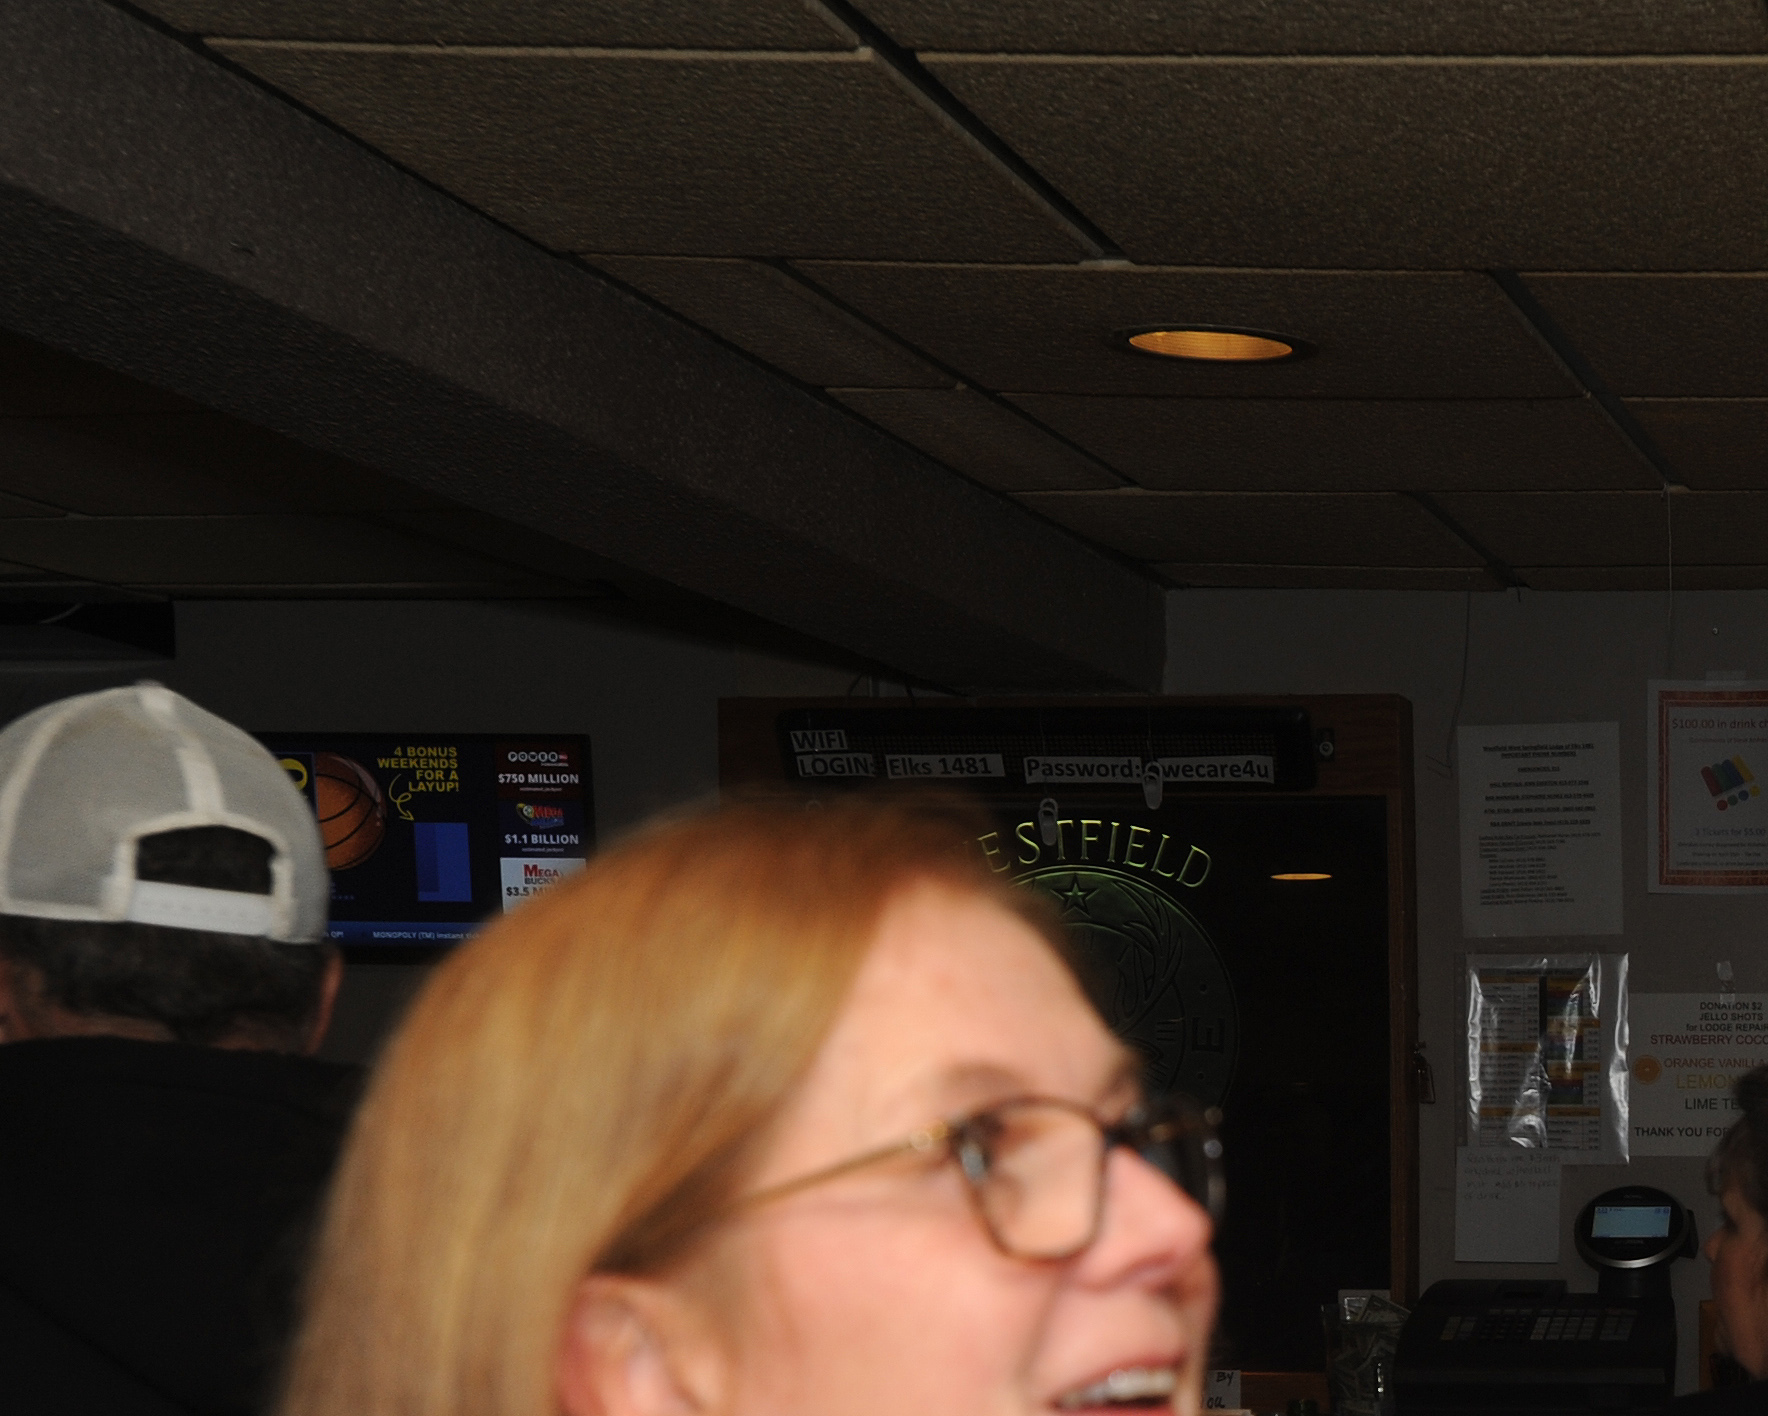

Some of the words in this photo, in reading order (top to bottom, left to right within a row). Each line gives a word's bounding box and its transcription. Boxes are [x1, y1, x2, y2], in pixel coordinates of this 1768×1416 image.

[1672, 719, 1715, 730] $100.00
[1717, 720, 1727, 729] in
[1730, 719, 1756, 730] drink
[793, 731, 844, 750] WIFI
[393, 746, 403, 757] 4
[406, 746, 458, 758] BONUS
[376, 758, 459, 769] WEEKENDS
[889, 758, 931, 776] Elks
[938, 757, 991, 775] 1481
[1027, 759, 1141, 778] Password:
[415, 770, 444, 781] FOR
[449, 770, 459, 780] A
[498, 773, 525, 784] $750
[528, 773, 579, 784] MILLION
[408, 782, 460, 793] LAYUP!
[504, 834, 528, 844] $1.1
[531, 834, 579, 845] BILLION
[964, 819, 1212, 888] ESTFIELD
[372, 931, 417, 939] MONOPOLY
[1700, 1001, 1749, 1011] DONATION
[1751, 1001, 1763, 1012] $2
[1700, 1012, 1728, 1022] JELLO
[1731, 1012, 1764, 1022] SHOTS
[1686, 1023, 1698, 1032] for
[1700, 1023, 1733, 1032] LODGE
[1650, 1035, 1733, 1045] STRAWBERRY
[1664, 1058, 1715, 1068] ORANGE
[1718, 1058, 1766, 1069] VANILLA
[1685, 1098, 1718, 1109] LIME
[1635, 1127, 1674, 1137] THANK
[1677, 1127, 1702, 1137] YOU
